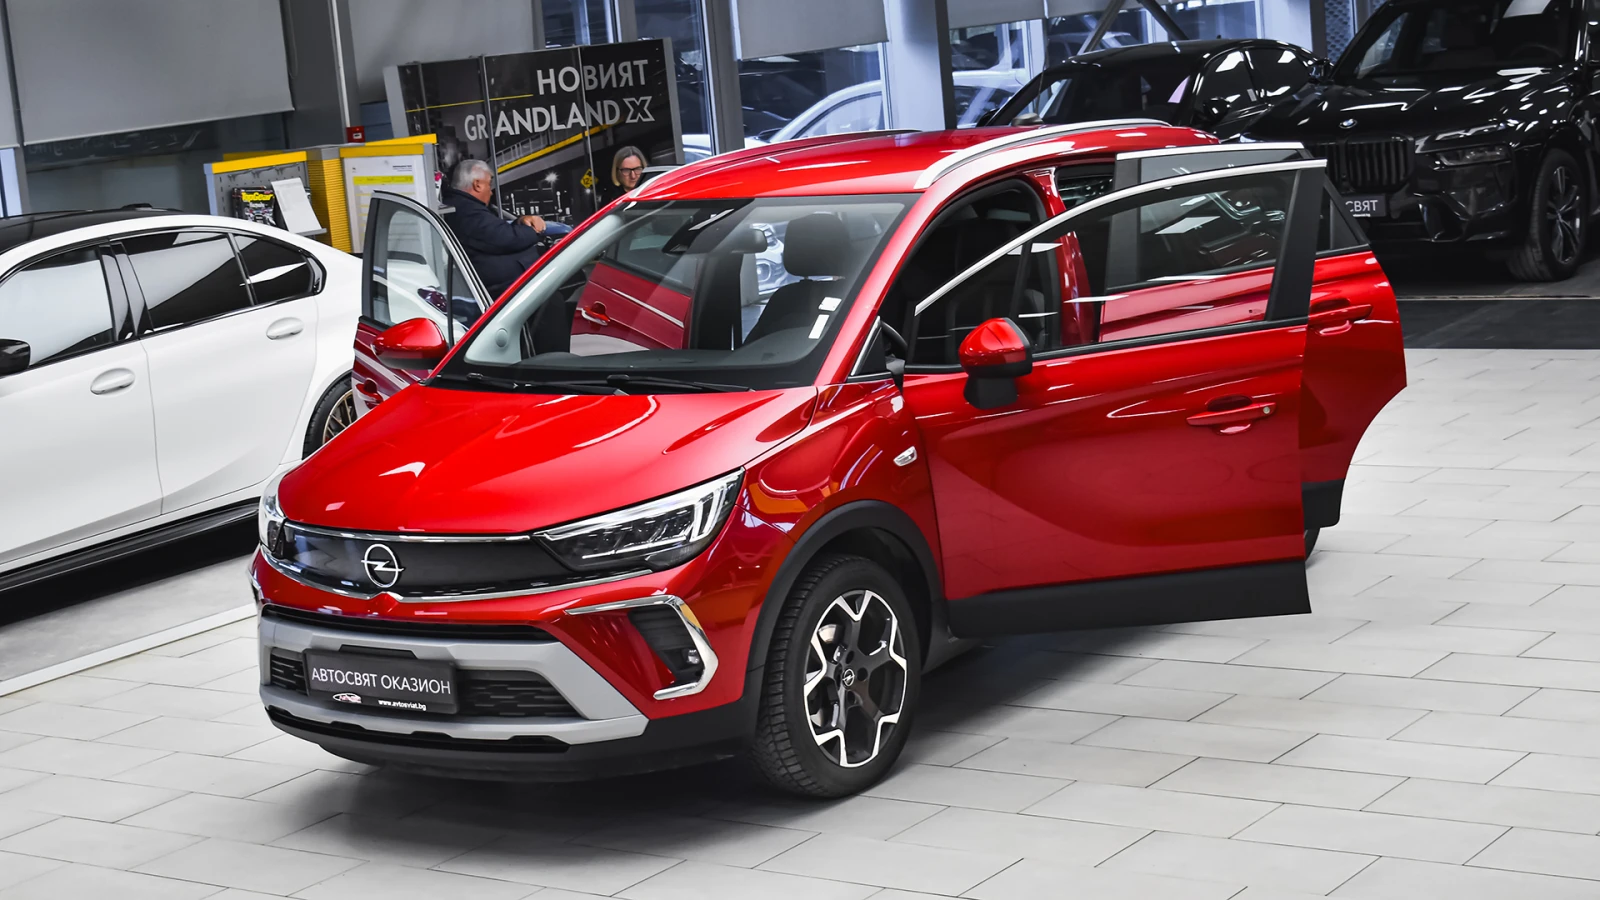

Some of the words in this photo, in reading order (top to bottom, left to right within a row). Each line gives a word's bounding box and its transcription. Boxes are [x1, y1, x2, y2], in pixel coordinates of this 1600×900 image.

[536, 59, 649, 95] НОВИЯТ
[464, 101, 621, 141] GRANDLAND
[623, 96, 655, 124] X
[311, 667, 378, 688] АВТОСВЯТ
[380, 674, 452, 695] ОКАЗИОН
[378, 699, 427, 712] www.avtosviat.bg
